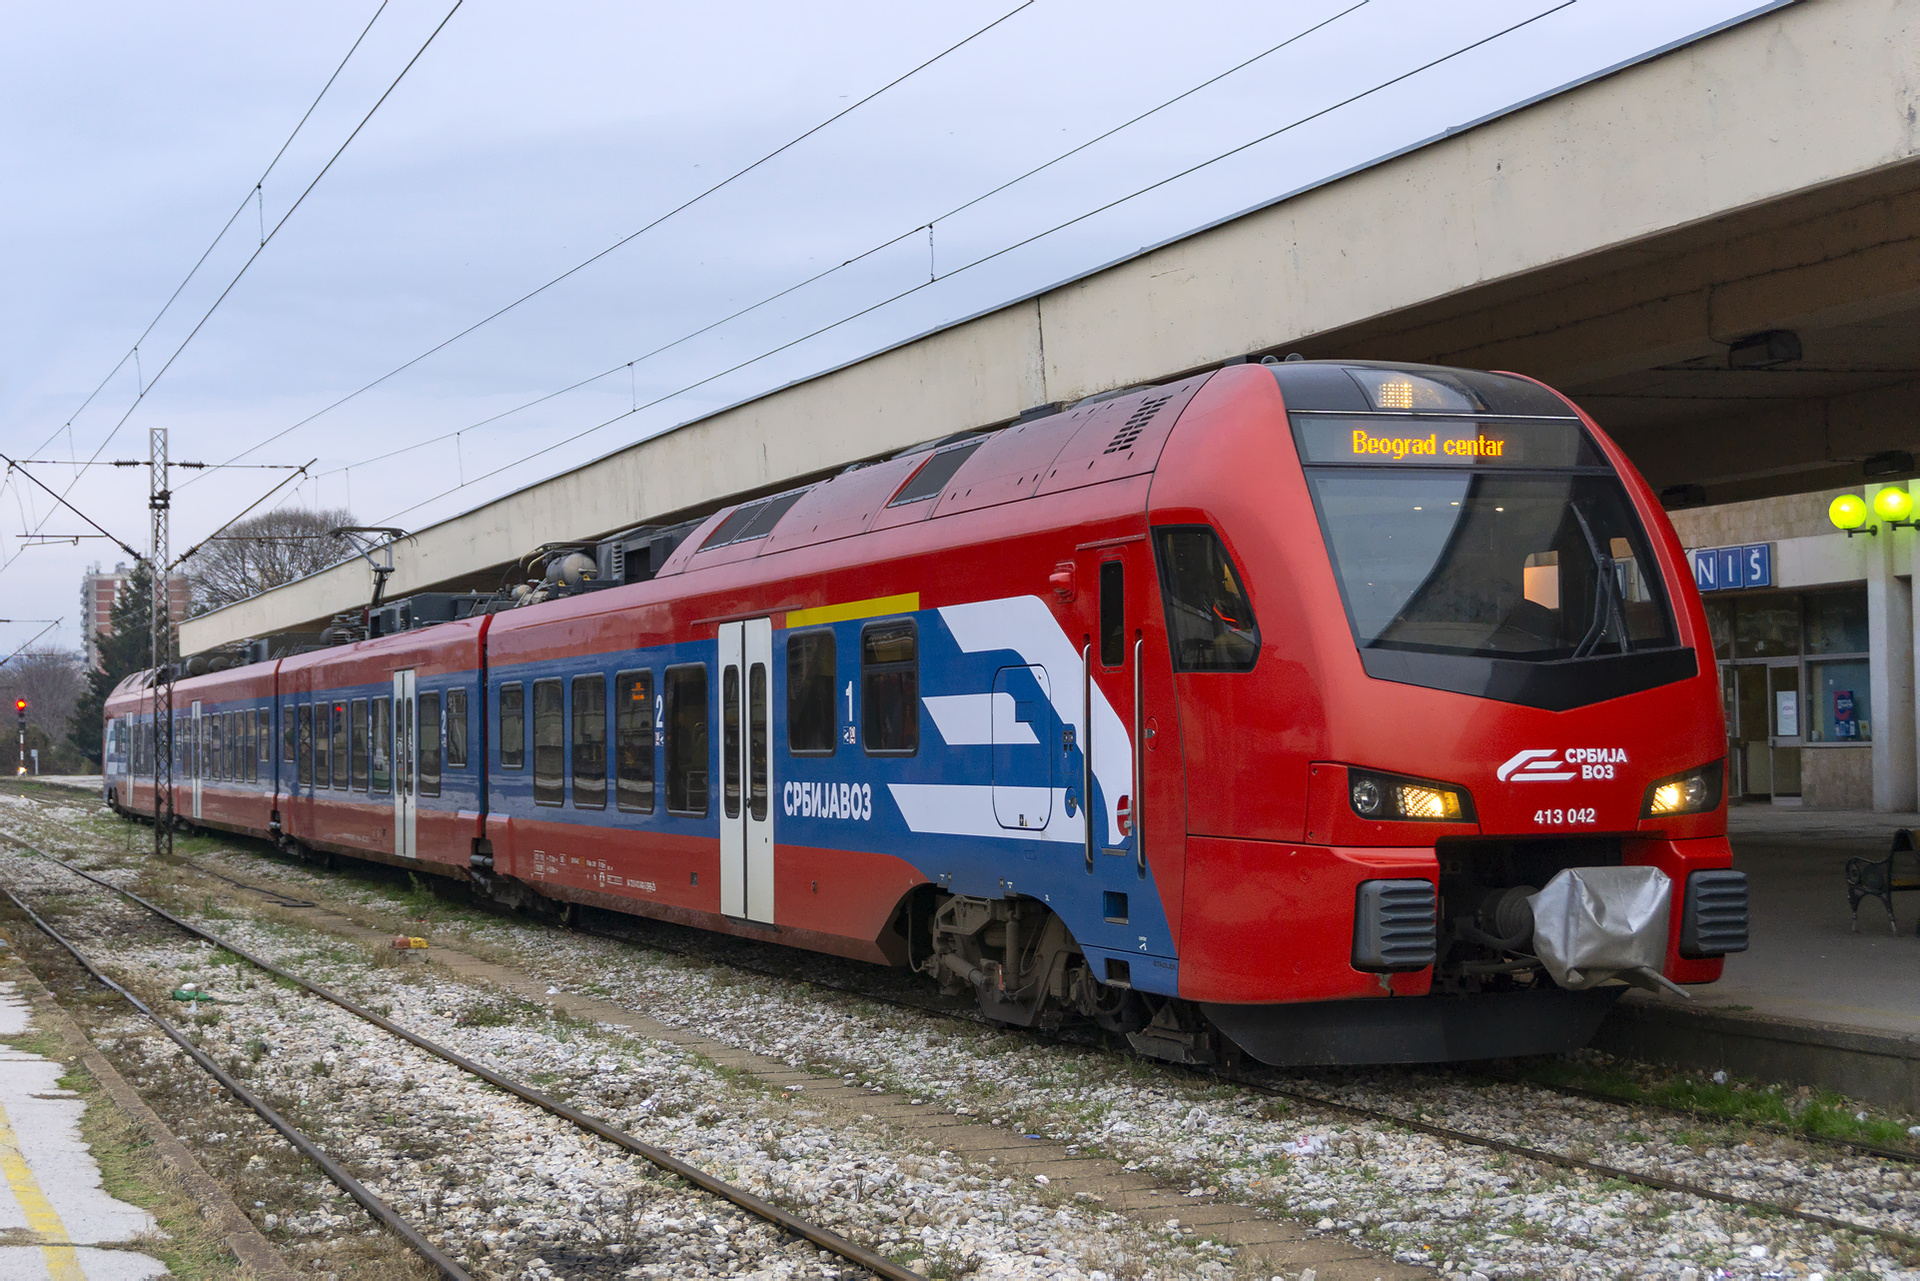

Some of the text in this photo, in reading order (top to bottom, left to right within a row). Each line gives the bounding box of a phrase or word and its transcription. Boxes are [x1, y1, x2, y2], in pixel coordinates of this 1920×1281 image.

[1353, 430, 1505, 460] Beograd centar
[1697, 549, 1761, 585] NIŠ
[656, 694, 664, 728] 2
[845, 680, 853, 722] 1
[1564, 748, 1628, 763] СРБИЈА
[1581, 764, 1614, 780] ВОЗ
[783, 780, 872, 821] СРБИЈАВОЗ
[1533, 807, 1596, 824] 413 042
